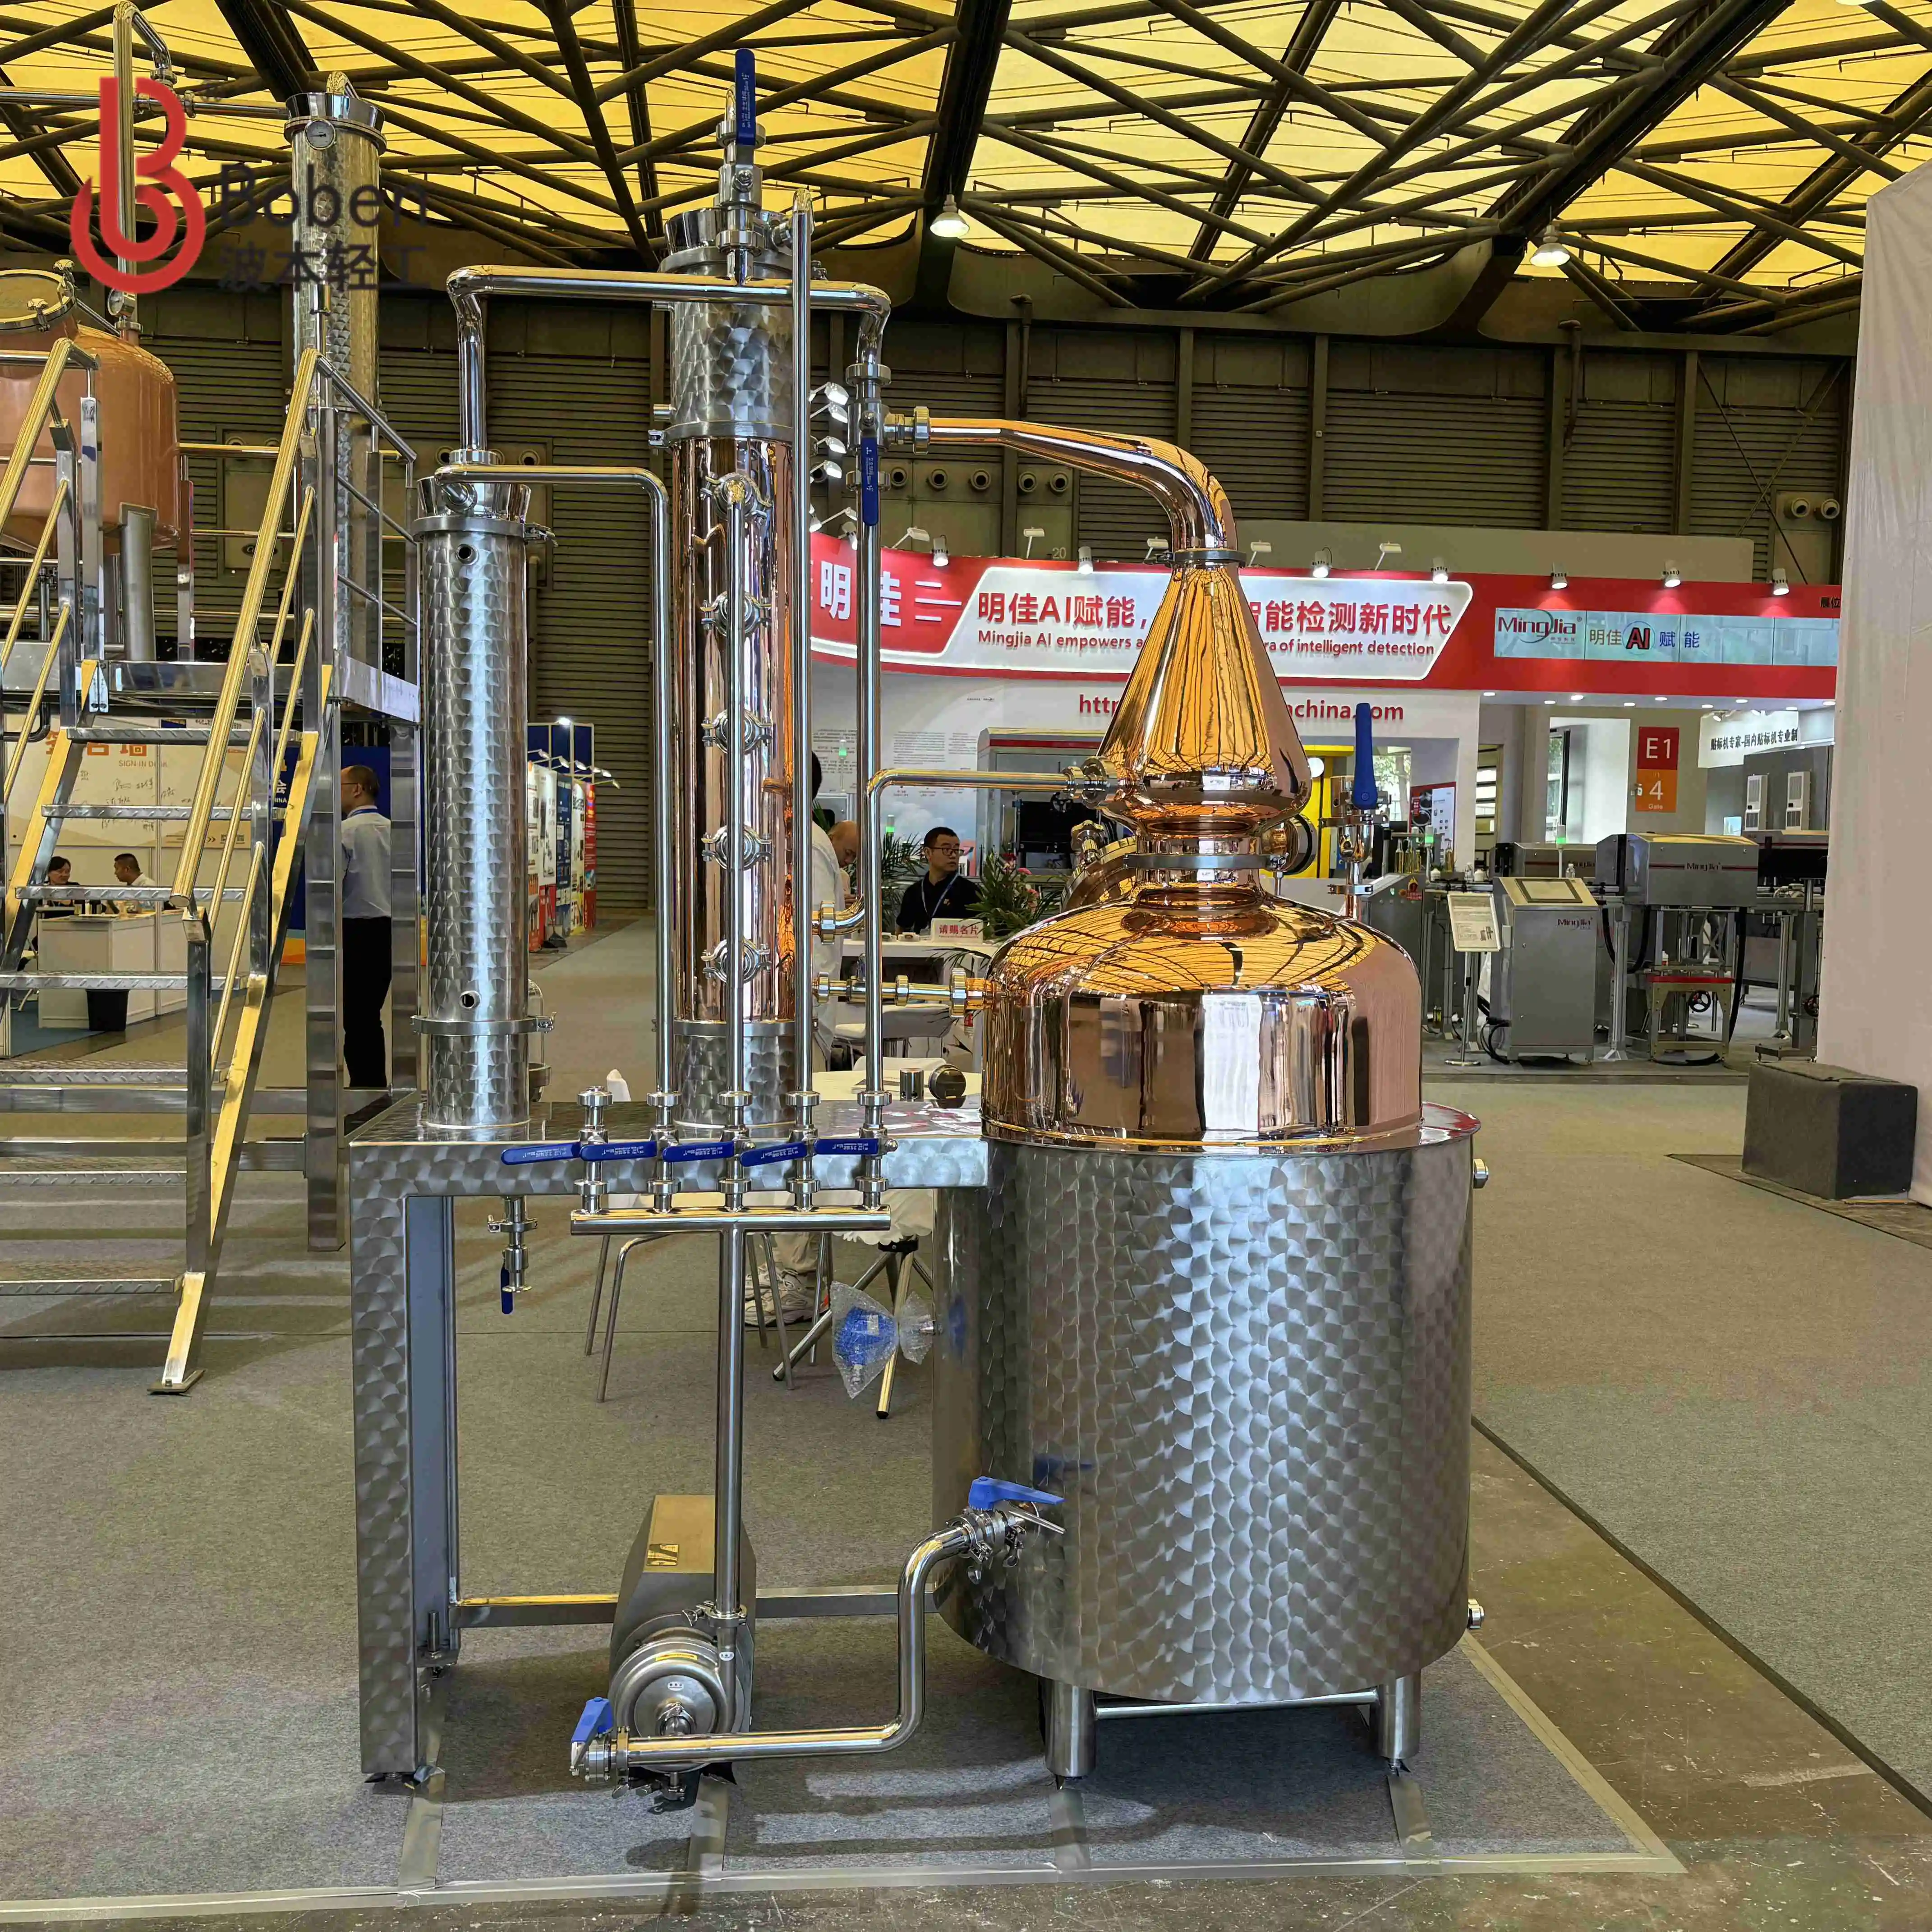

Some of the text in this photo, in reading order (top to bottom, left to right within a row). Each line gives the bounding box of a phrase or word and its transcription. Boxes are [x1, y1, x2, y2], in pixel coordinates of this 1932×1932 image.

[1052, 547, 1066, 559] 20
[978, 630, 1031, 648] Mingjia
[1037, 633, 1052, 645] AI
[1057, 635, 1131, 651] empowers
[1279, 639, 1294, 652] of
[1297, 639, 1363, 656] intelligent
[1367, 640, 1435, 655] detection
[1646, 737, 1670, 759] E1
[1649, 780, 1663, 800] 4
